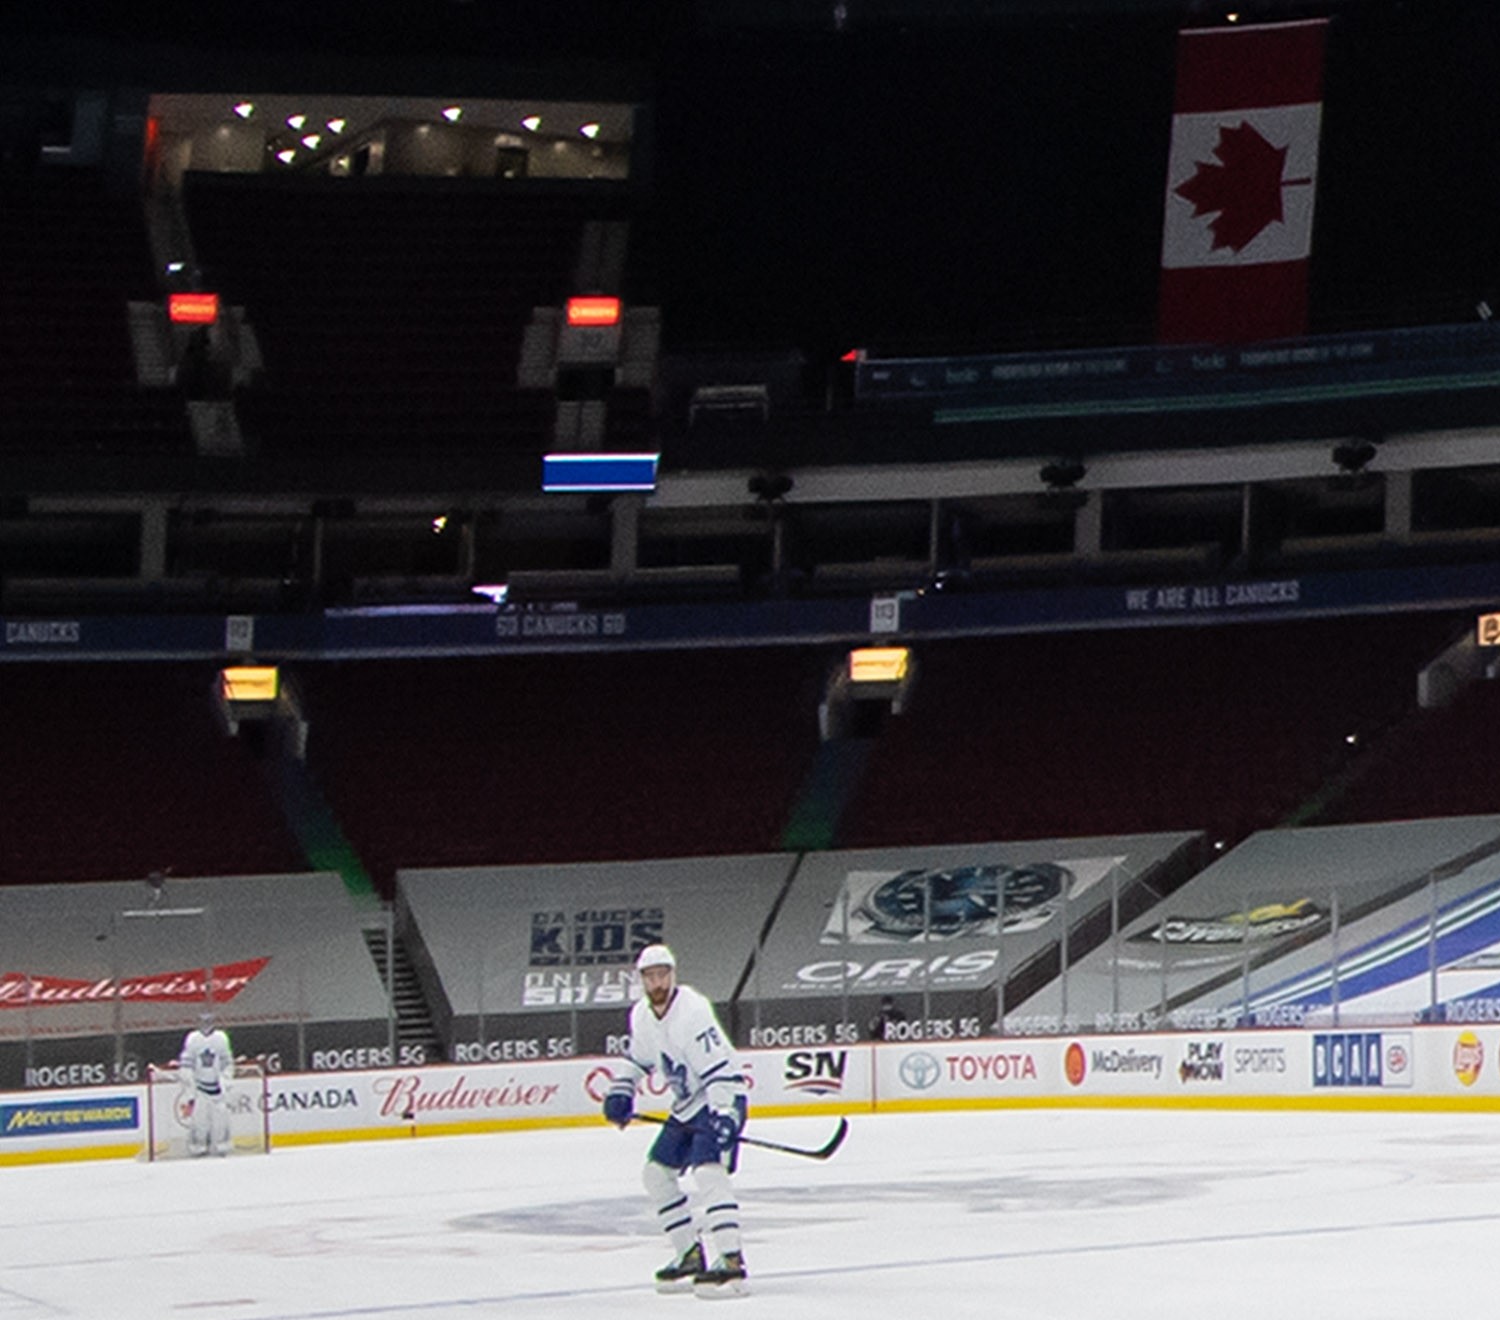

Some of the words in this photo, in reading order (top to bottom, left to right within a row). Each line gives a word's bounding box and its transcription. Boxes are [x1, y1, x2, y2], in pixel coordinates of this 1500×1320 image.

[1225, 579, 1299, 606] CANUCKS
[6, 620, 80, 643] CANUCKS
[522, 614, 598, 636] CANUCKS
[797, 950, 999, 983] ORIS
[751, 1024, 827, 1046] ROGERS
[834, 1022, 858, 1043] 5G
[885, 1019, 953, 1042] ROGERS
[959, 1016, 981, 1037] 5G
[313, 1049, 393, 1070] ROGERS
[401, 1046, 426, 1067] 5G
[456, 1040, 539, 1063] ROGERS
[548, 1037, 574, 1056] 5G
[1188, 1043, 1223, 1060] PLAY
[1314, 1042, 1381, 1081] BCAA
[26, 1062, 105, 1087] ROGERS
[784, 1051, 847, 1080] SN
[945, 1053, 1038, 1081] TOYOTA
[261, 1088, 359, 1113] CANADA
[373, 1075, 561, 1118] Budweiser
